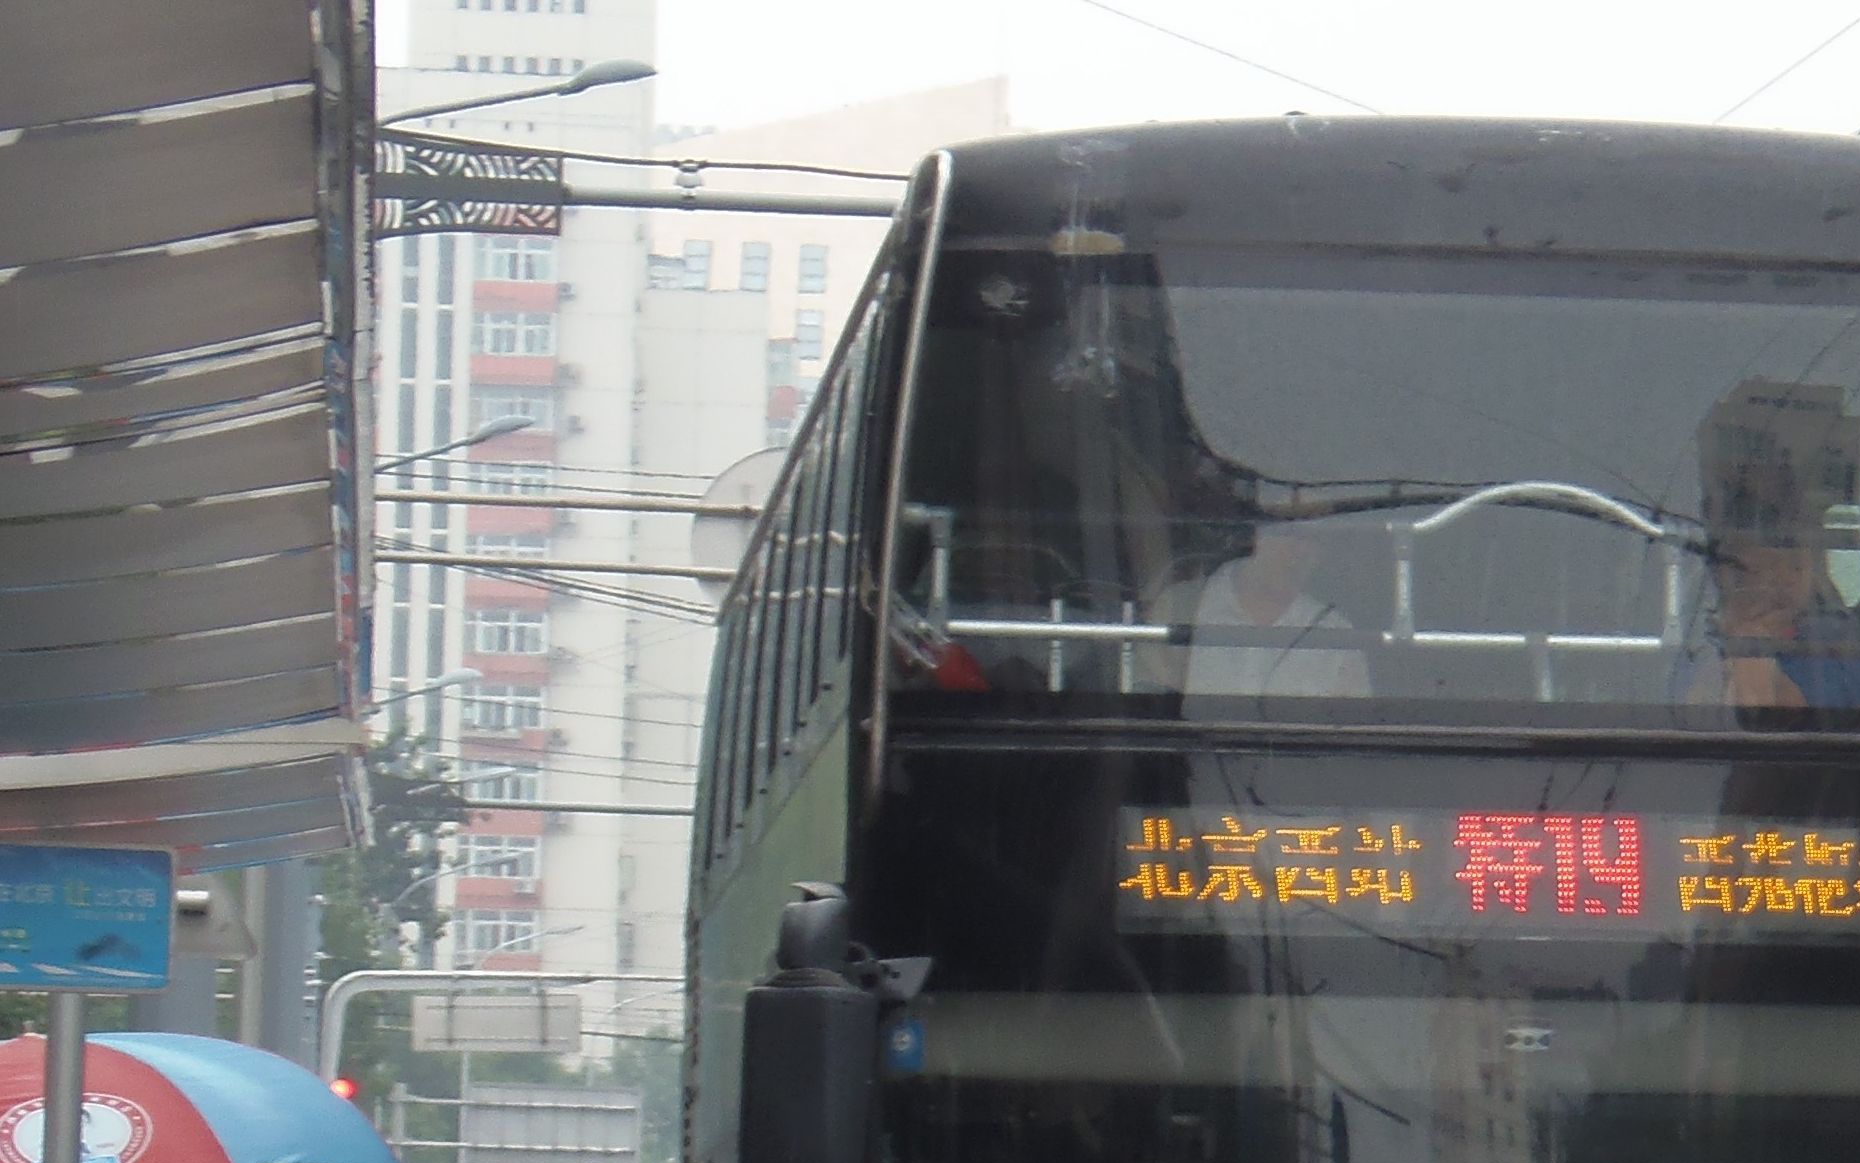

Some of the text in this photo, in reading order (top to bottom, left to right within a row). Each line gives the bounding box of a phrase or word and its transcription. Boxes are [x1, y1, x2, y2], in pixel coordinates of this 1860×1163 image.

[1119, 816, 1422, 904] 北京西站
[1453, 814, 1643, 914] 特19
